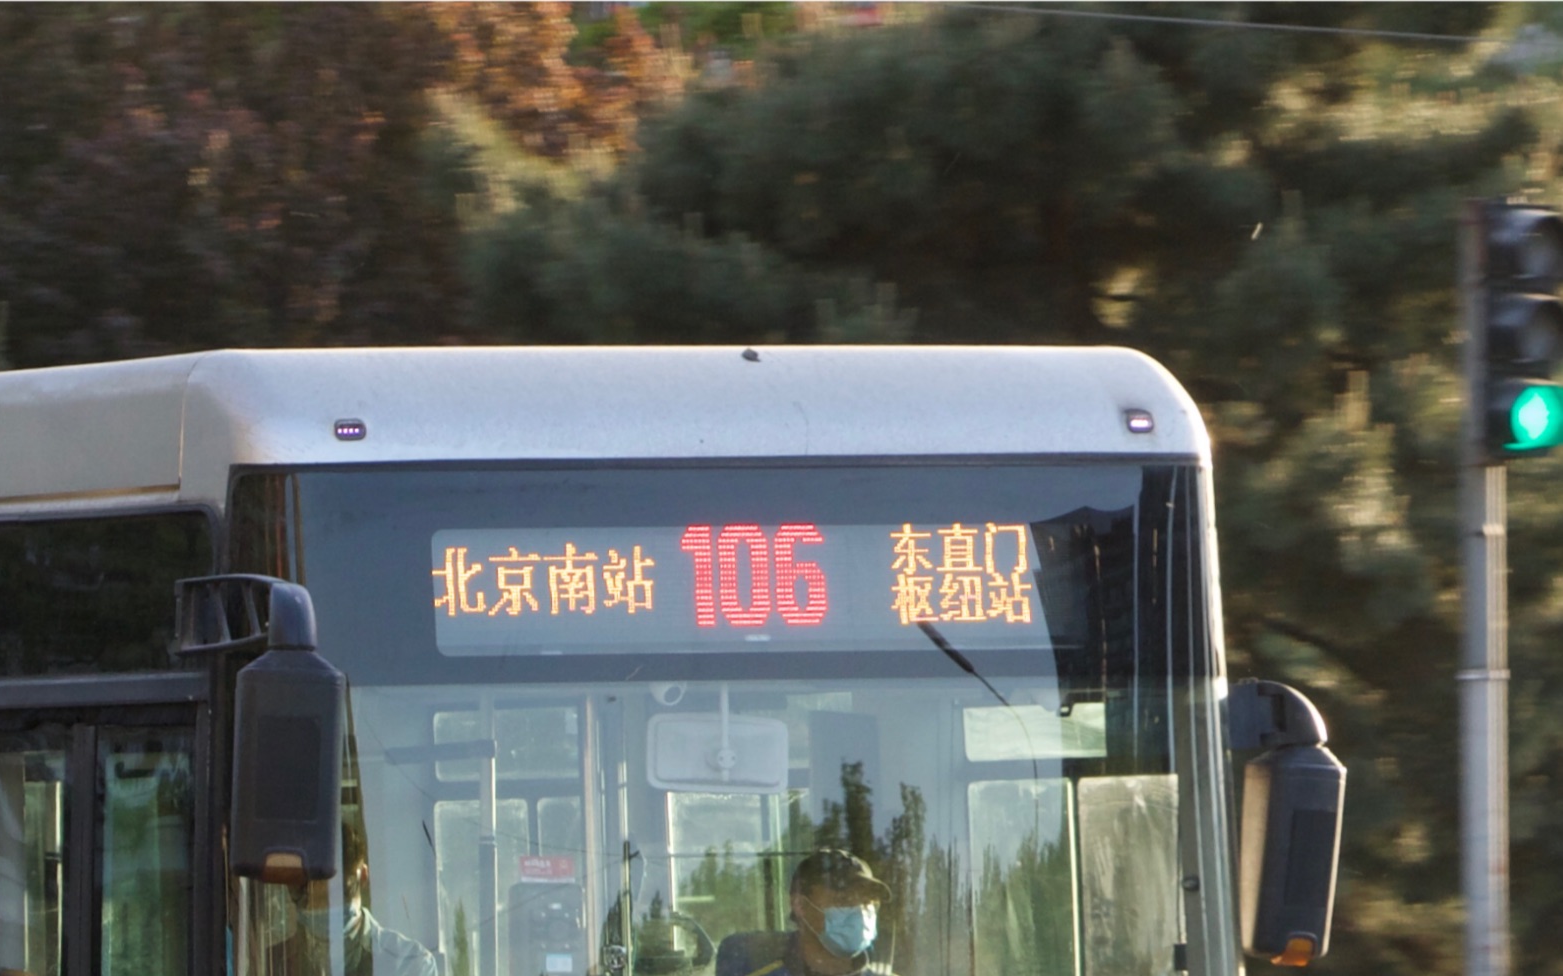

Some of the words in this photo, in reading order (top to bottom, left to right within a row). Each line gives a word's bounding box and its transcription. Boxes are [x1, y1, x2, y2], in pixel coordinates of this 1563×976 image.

[432, 542, 656, 617] 北京南站
[680, 523, 827, 627] 106
[889, 523, 1029, 573] 东直门
[890, 573, 1032, 625] 枢纽站
